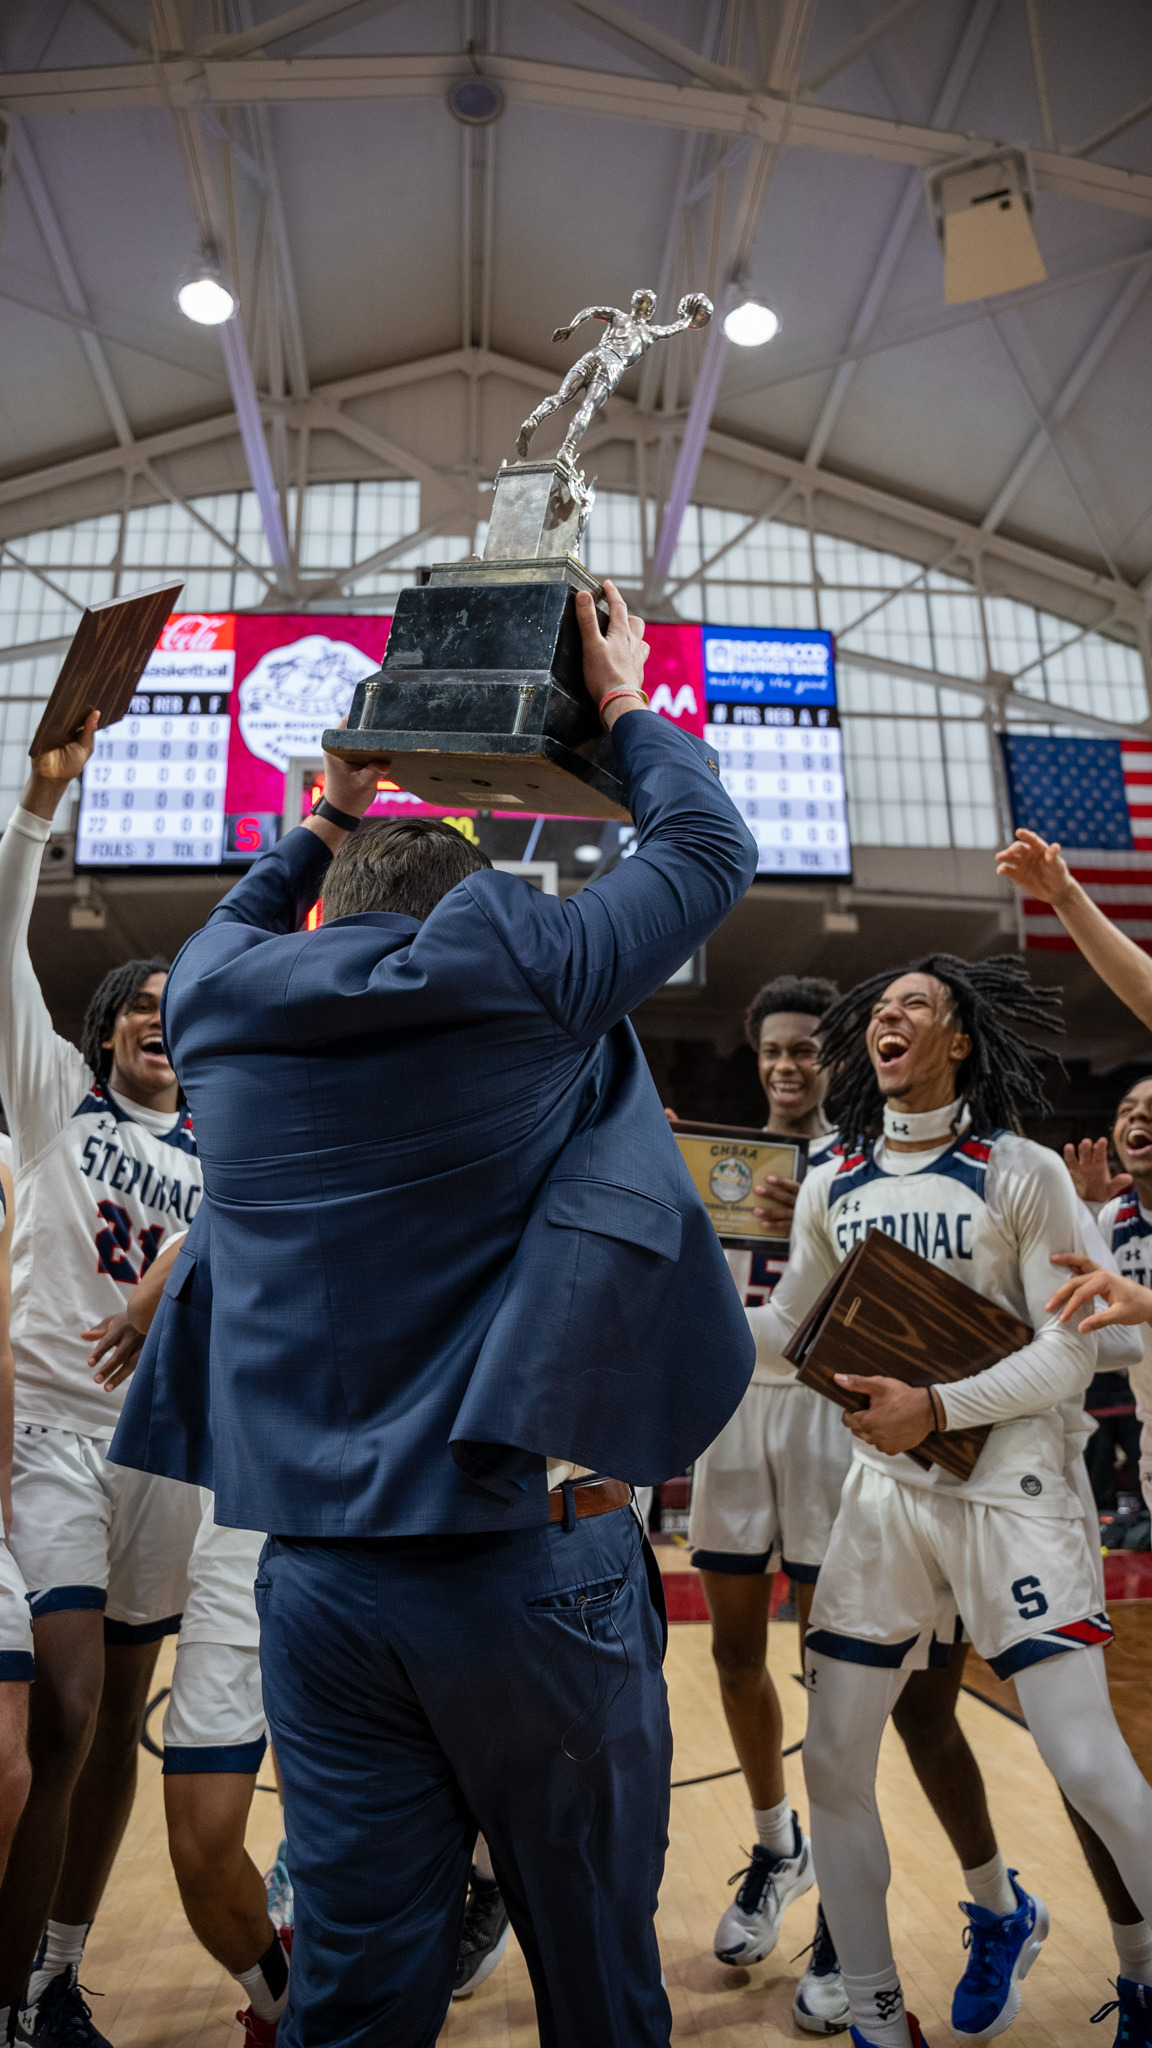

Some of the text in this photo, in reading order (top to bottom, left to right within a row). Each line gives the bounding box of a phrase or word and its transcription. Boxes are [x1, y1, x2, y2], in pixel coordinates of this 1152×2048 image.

[710, 1145, 758, 1159] CHSAA
[80, 1135, 201, 1225] STEPINAC
[1011, 1575, 1048, 1620] S
